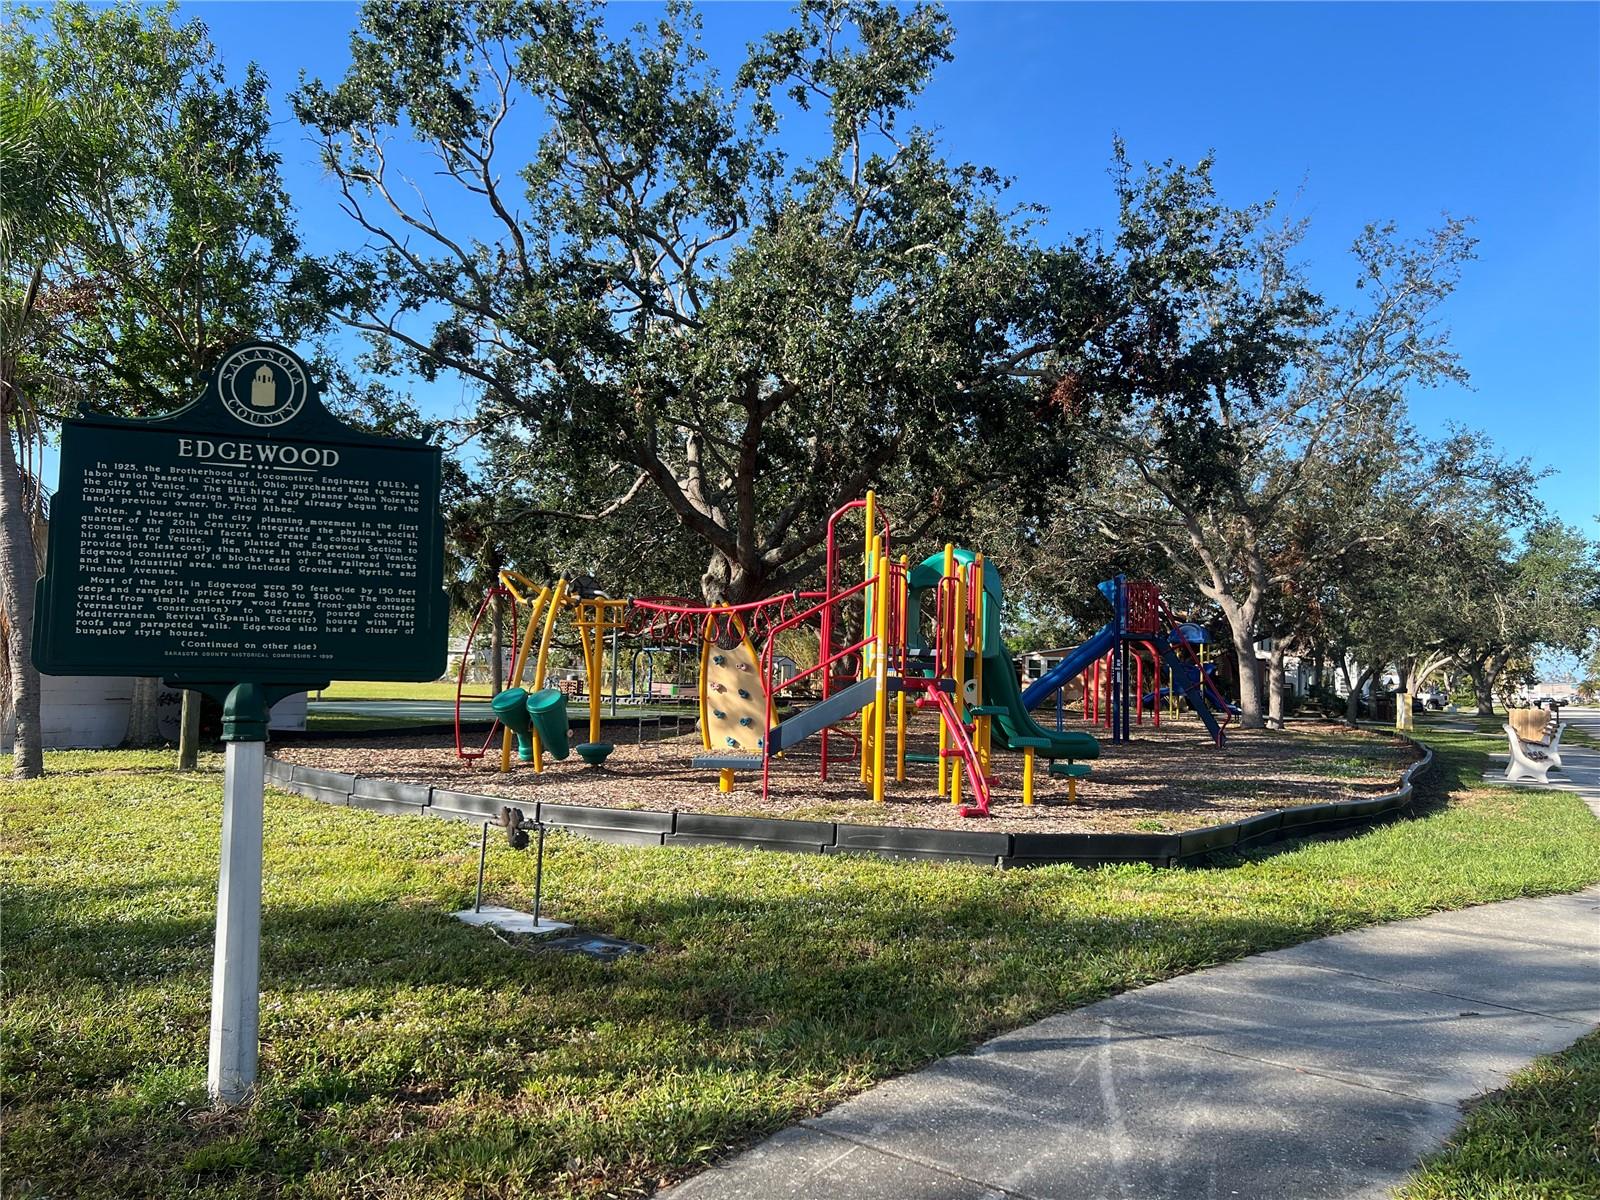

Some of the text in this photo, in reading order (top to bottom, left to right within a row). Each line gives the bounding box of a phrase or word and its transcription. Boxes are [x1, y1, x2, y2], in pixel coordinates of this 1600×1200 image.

[223, 350, 302, 385] SARASOTA
[227, 399, 296, 424] COUNTY
[178, 439, 340, 467] EDGEWOOD
[84, 468, 114, 477] labor
[154, 473, 184, 482] based
[292, 483, 342, 492] purchased
[348, 486, 368, 494] land
[96, 461, 107, 469] In
[144, 464, 160, 472] the
[169, 466, 232, 477] Brotherhood
[256, 472, 313, 482] Locomotive
[322, 476, 369, 486] Engineers
[82, 487, 131, 495] complete
[162, 490, 183, 499] city
[189, 492, 222, 501] design
[281, 497, 298, 505] had
[304, 499, 342, 509] already
[348, 502, 376, 510] begun
[107, 479, 405, 504] city Venice. The BLE hired city planner John Nolen
[82, 494, 295, 513] land's previous Dr. Fred Albee.
[149, 509, 183, 517] leader
[231, 514, 252, 522] city
[261, 515, 302, 525] planning
[309, 519, 356, 527] movement
[172, 518, 196, 526] 20th
[256, 523, 310, 532] integrated
[80, 530, 96, 538] his
[103, 532, 138, 541] design
[167, 534, 204, 543] Venice.
[244, 538, 280, 547] platted
[311, 541, 359, 551] Edgewood
[367, 544, 402, 553] Section
[169, 527, 213, 535] political
[220, 529, 252, 537] facets
[329, 534, 370, 543] cohesive
[80, 547, 131, 556] Edgewood
[137, 551, 188, 559] consisted
[228, 554, 260, 562] blocks
[341, 560, 380, 568] railroad
[154, 542, 174, 550] less
[180, 544, 211, 553] costly
[218, 545, 240, 553] than
[326, 551, 365, 559] sections
[384, 553, 416, 561] Venice.
[79, 564, 178, 575] Pineland Avenues.
[130, 558, 182, 567] industrial
[247, 563, 290, 571] included
[77, 584, 103, 593] deep
[135, 587, 172, 595] ranged
[231, 589, 255, 597] from
[263, 590, 289, 598] $850
[313, 592, 344, 600] $1600.
[359, 594, 377, 602] The
[90, 576, 114, 584] Most
[207, 580, 256, 589] Edgewood
[310, 584, 328, 592] feet
[361, 587, 372, 595] by
[76, 601, 142, 610] (vernacular
[264, 608, 314, 616] one-story
[77, 593, 112, 601] varied
[120, 594, 144, 602] from
[152, 595, 185, 604] simple
[193, 598, 242, 606] one-story
[317, 601, 370, 610] front-gable
[376, 604, 415, 612] cottages
[76, 609, 155, 619] Mediterranean
[166, 612, 204, 620] Revival
[213, 613, 260, 622] (Spanish
[269, 615, 316, 623] Eclectic)
[75, 626, 207, 637] bungalow style houses.
[76, 618, 104, 626] roofs
[140, 621, 193, 629] parapeted
[242, 623, 290, 632] Edgewood
[364, 626, 398, 634] cluster
[180, 640, 238, 648] (Continued
